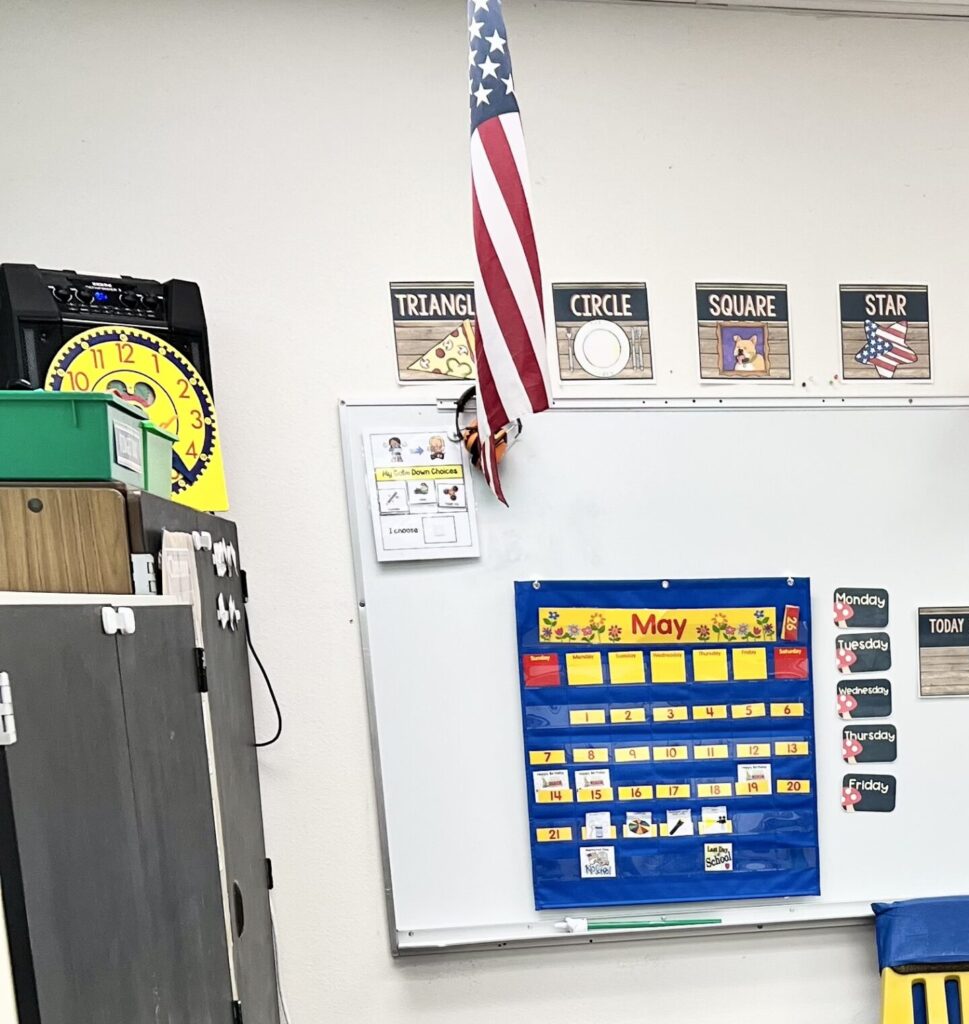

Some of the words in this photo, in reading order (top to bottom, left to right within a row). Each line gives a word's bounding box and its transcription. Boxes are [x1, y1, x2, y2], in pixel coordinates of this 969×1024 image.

[394, 293, 476, 317] TRIANGL
[570, 294, 633, 317] CIRCLE
[709, 294, 776, 318] SQUARE
[865, 294, 907, 317] STAR
[116, 343, 135, 363] 12
[90, 349, 105, 369] 11
[152, 354, 160, 373] 1
[68, 371, 89, 391] 10
[177, 379, 190, 398] 2
[190, 409, 203, 429] 3
[185, 440, 198, 459] 4
[411, 468, 430, 476] Down
[431, 467, 458, 475] Choices
[835, 592, 886, 609] Monday
[631, 613, 687, 640] May
[786, 616, 798, 631] 26
[929, 618, 964, 633] TODAY
[837, 639, 888, 651] Tuesday
[838, 685, 889, 696] Wednesday
[625, 711, 632, 720] 2
[667, 709, 674, 719] 3
[706, 707, 714, 717] 4
[745, 706, 752, 715] 5
[784, 705, 791, 715] 6
[585, 712, 589, 722] 1
[844, 730, 895, 742] Thursday
[666, 747, 677, 757] 10
[707, 747, 714, 757] 11
[749, 745, 759, 755] 12
[787, 743, 798, 753] 13
[544, 752, 551, 762] 7
[588, 750, 595, 760] 8
[629, 749, 636, 759] 9
[669, 786, 679, 796] 17
[710, 785, 721, 795] 18
[748, 782, 758, 792] 19
[787, 781, 801, 791] 20
[849, 778, 889, 793] Friday
[550, 790, 562, 801] 14
[591, 789, 602, 800] 15
[631, 788, 642, 798] 16
[548, 829, 560, 839] 21
[705, 851, 732, 868] School
